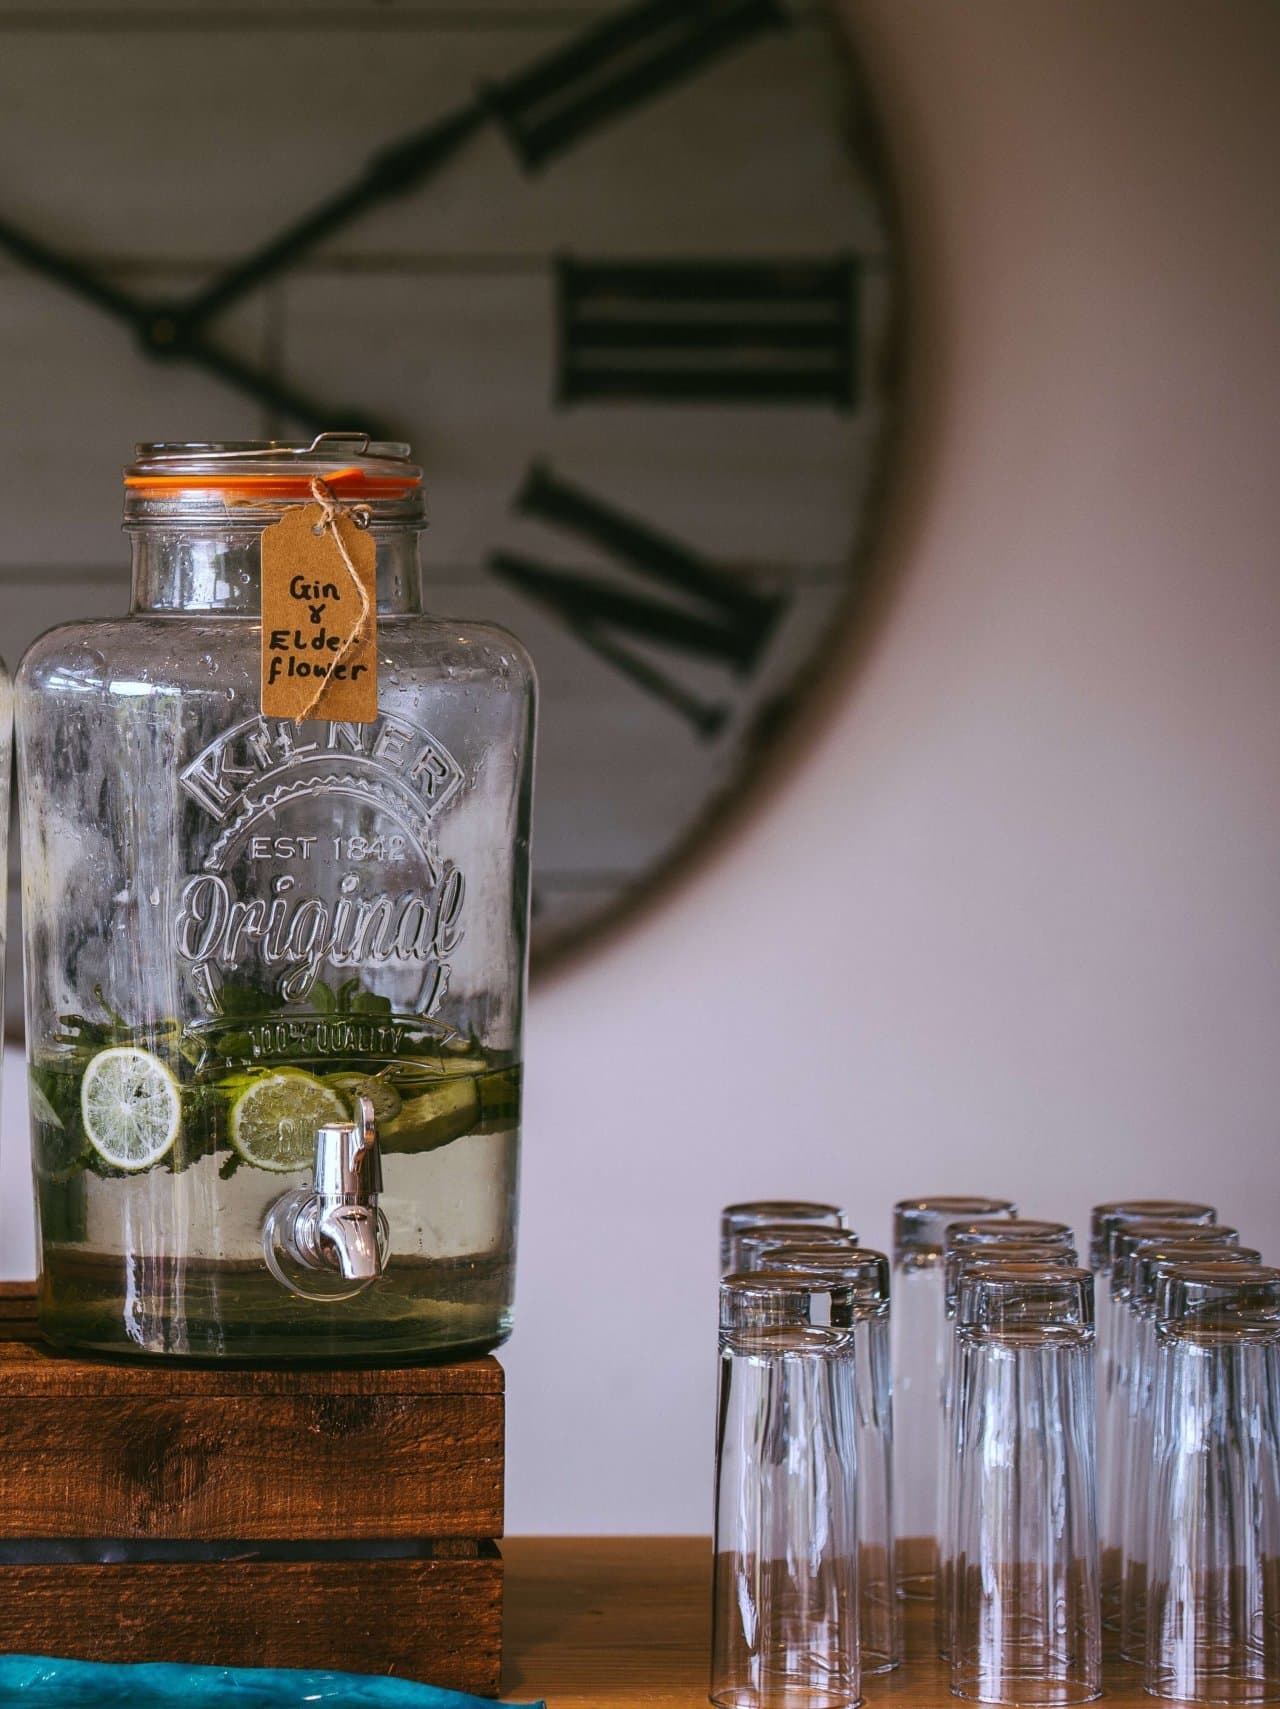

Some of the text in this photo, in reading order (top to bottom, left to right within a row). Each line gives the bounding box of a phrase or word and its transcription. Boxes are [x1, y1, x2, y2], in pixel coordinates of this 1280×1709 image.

[552, 247, 865, 416] III
[289, 575, 341, 601] Gin
[267, 655, 369, 685] flower
[188, 716, 454, 802] KILNER
[249, 836, 408, 862] EST 1842
[175, 860, 466, 1003] Original
[316, 1022, 403, 1055] QUALITY
